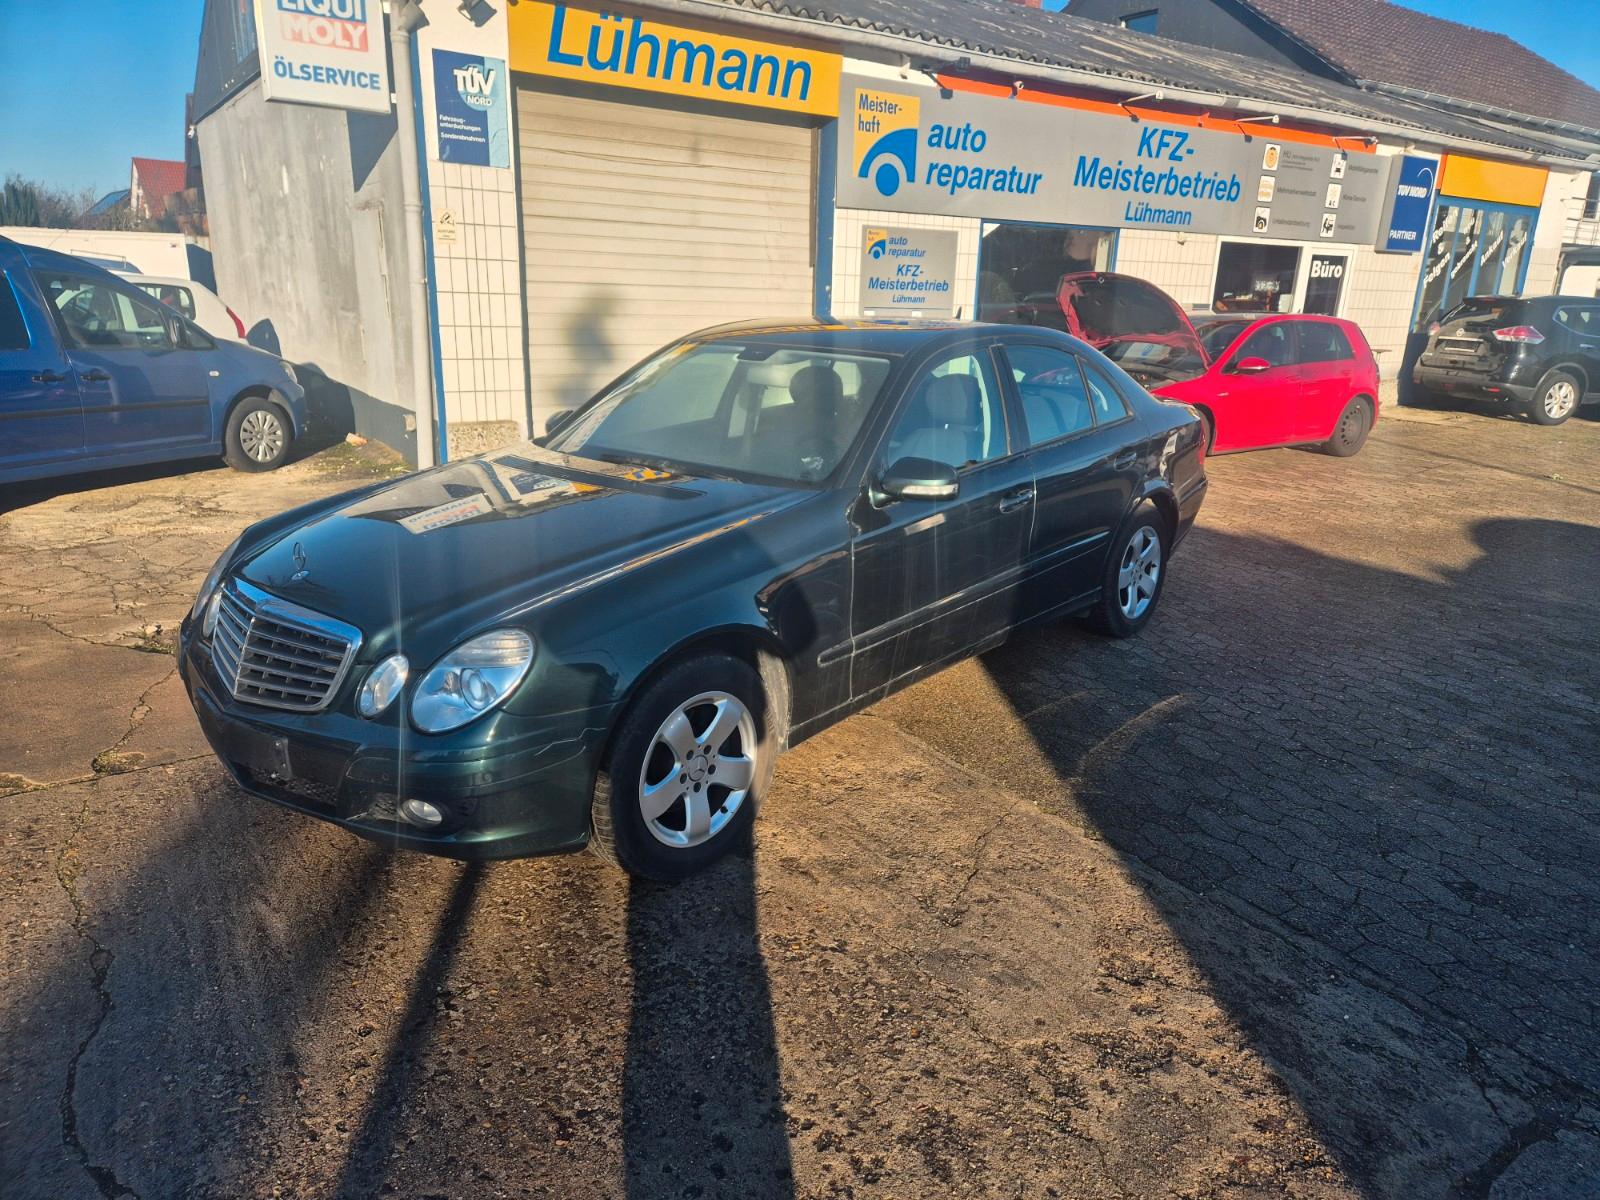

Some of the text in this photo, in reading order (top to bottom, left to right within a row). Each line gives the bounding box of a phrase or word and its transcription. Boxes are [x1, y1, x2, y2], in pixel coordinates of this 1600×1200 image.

[281, 17, 366, 49] MOLY
[547, 4, 812, 101] Lühmann
[273, 55, 381, 91] ÖLSERVICE
[453, 66, 496, 96] TÜV
[466, 95, 493, 107] NORD
[858, 93, 903, 115] Meister-
[857, 114, 881, 134] haft
[927, 122, 987, 153] auto
[1137, 126, 1195, 162] KFZ-
[926, 162, 1043, 196] reparatur
[1073, 155, 1241, 202] Meisterbetrieb
[1124, 201, 1193, 225] Lühmann
[888, 236, 908, 246] auto
[1389, 229, 1417, 241] PARTNER
[888, 248, 926, 258] reparatur
[896, 263, 924, 277] KFZ-
[1310, 260, 1343, 279] Büro
[868, 276, 949, 292] Meisterbetrieb
